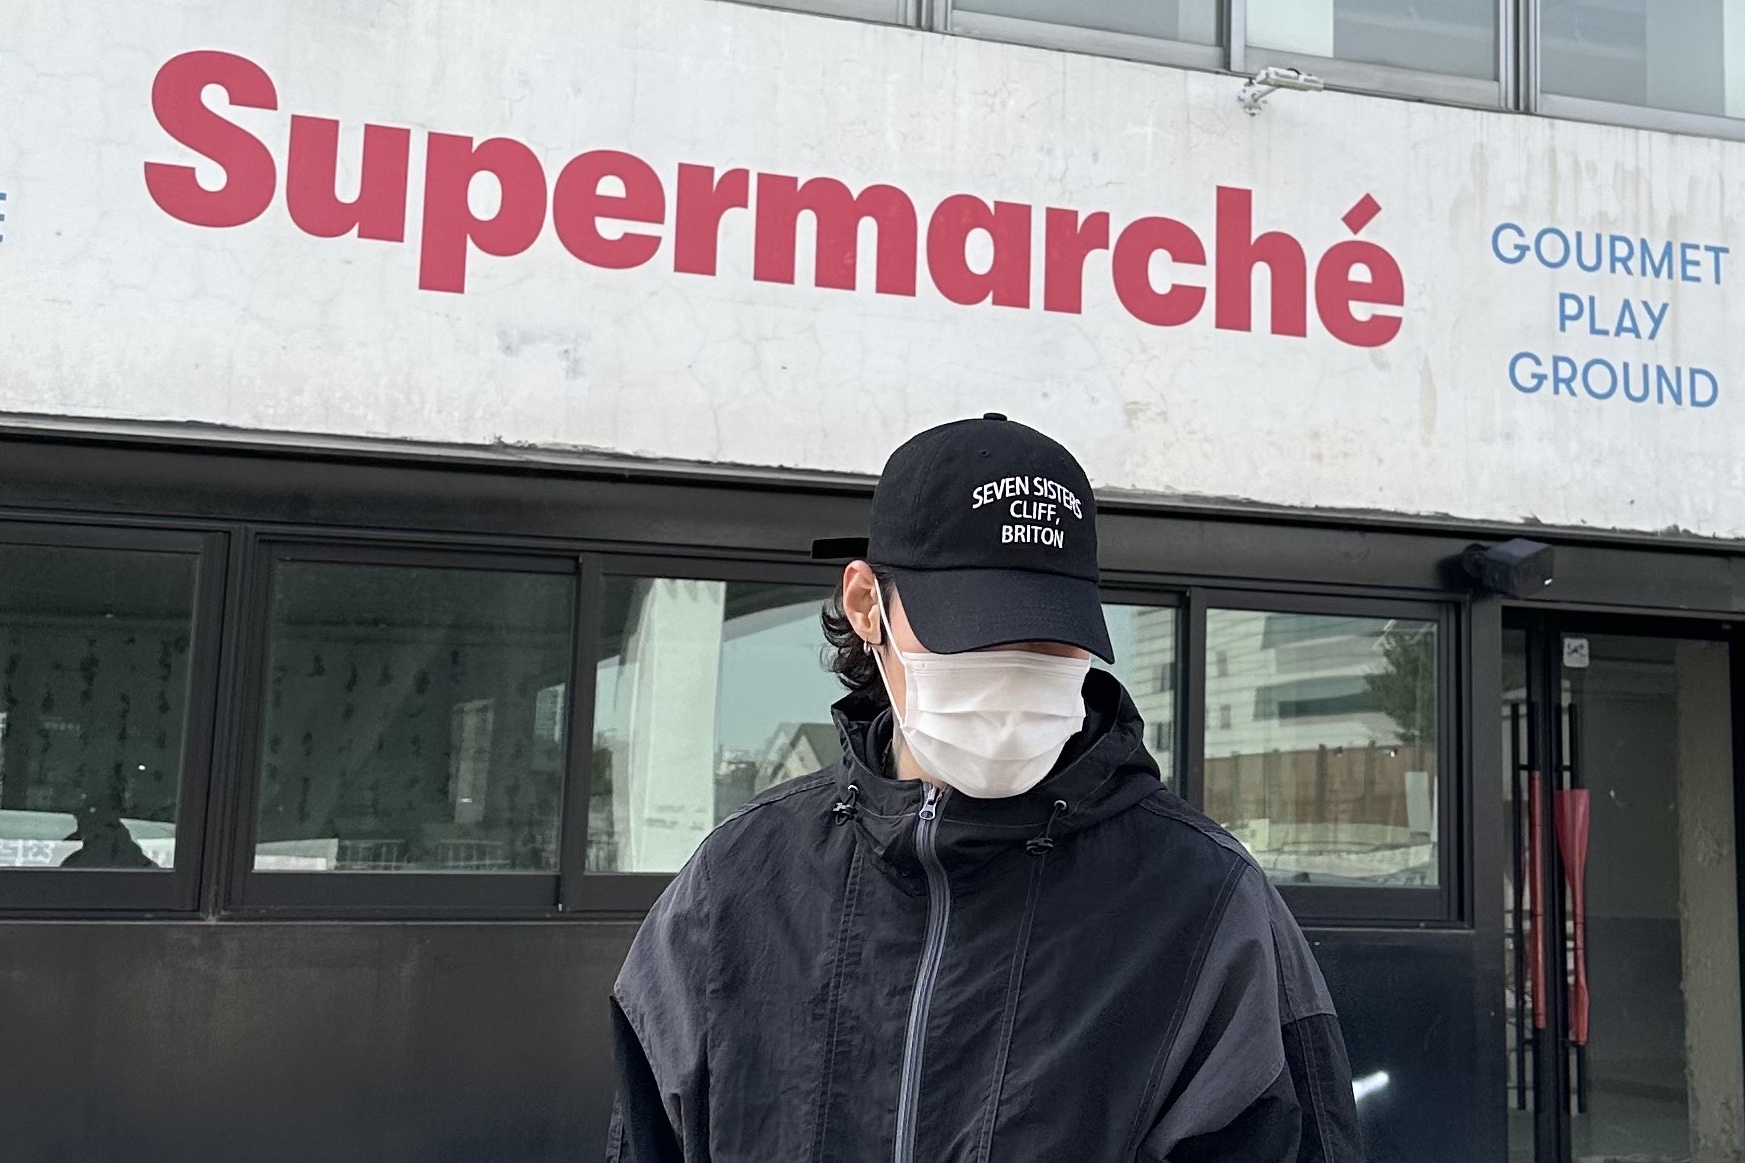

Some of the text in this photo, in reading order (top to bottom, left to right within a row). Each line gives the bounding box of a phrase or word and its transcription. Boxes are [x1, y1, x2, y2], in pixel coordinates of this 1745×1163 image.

[144, 50, 1405, 348] Supermarché
[1490, 222, 1730, 285] GOURMET
[1557, 291, 1669, 341] PLAY
[1508, 351, 1719, 409] GROUND
[972, 475, 1083, 520] SEVEN SISTERS
[1009, 499, 1061, 526] CLIFF,
[1001, 524, 1065, 549] BRITON
